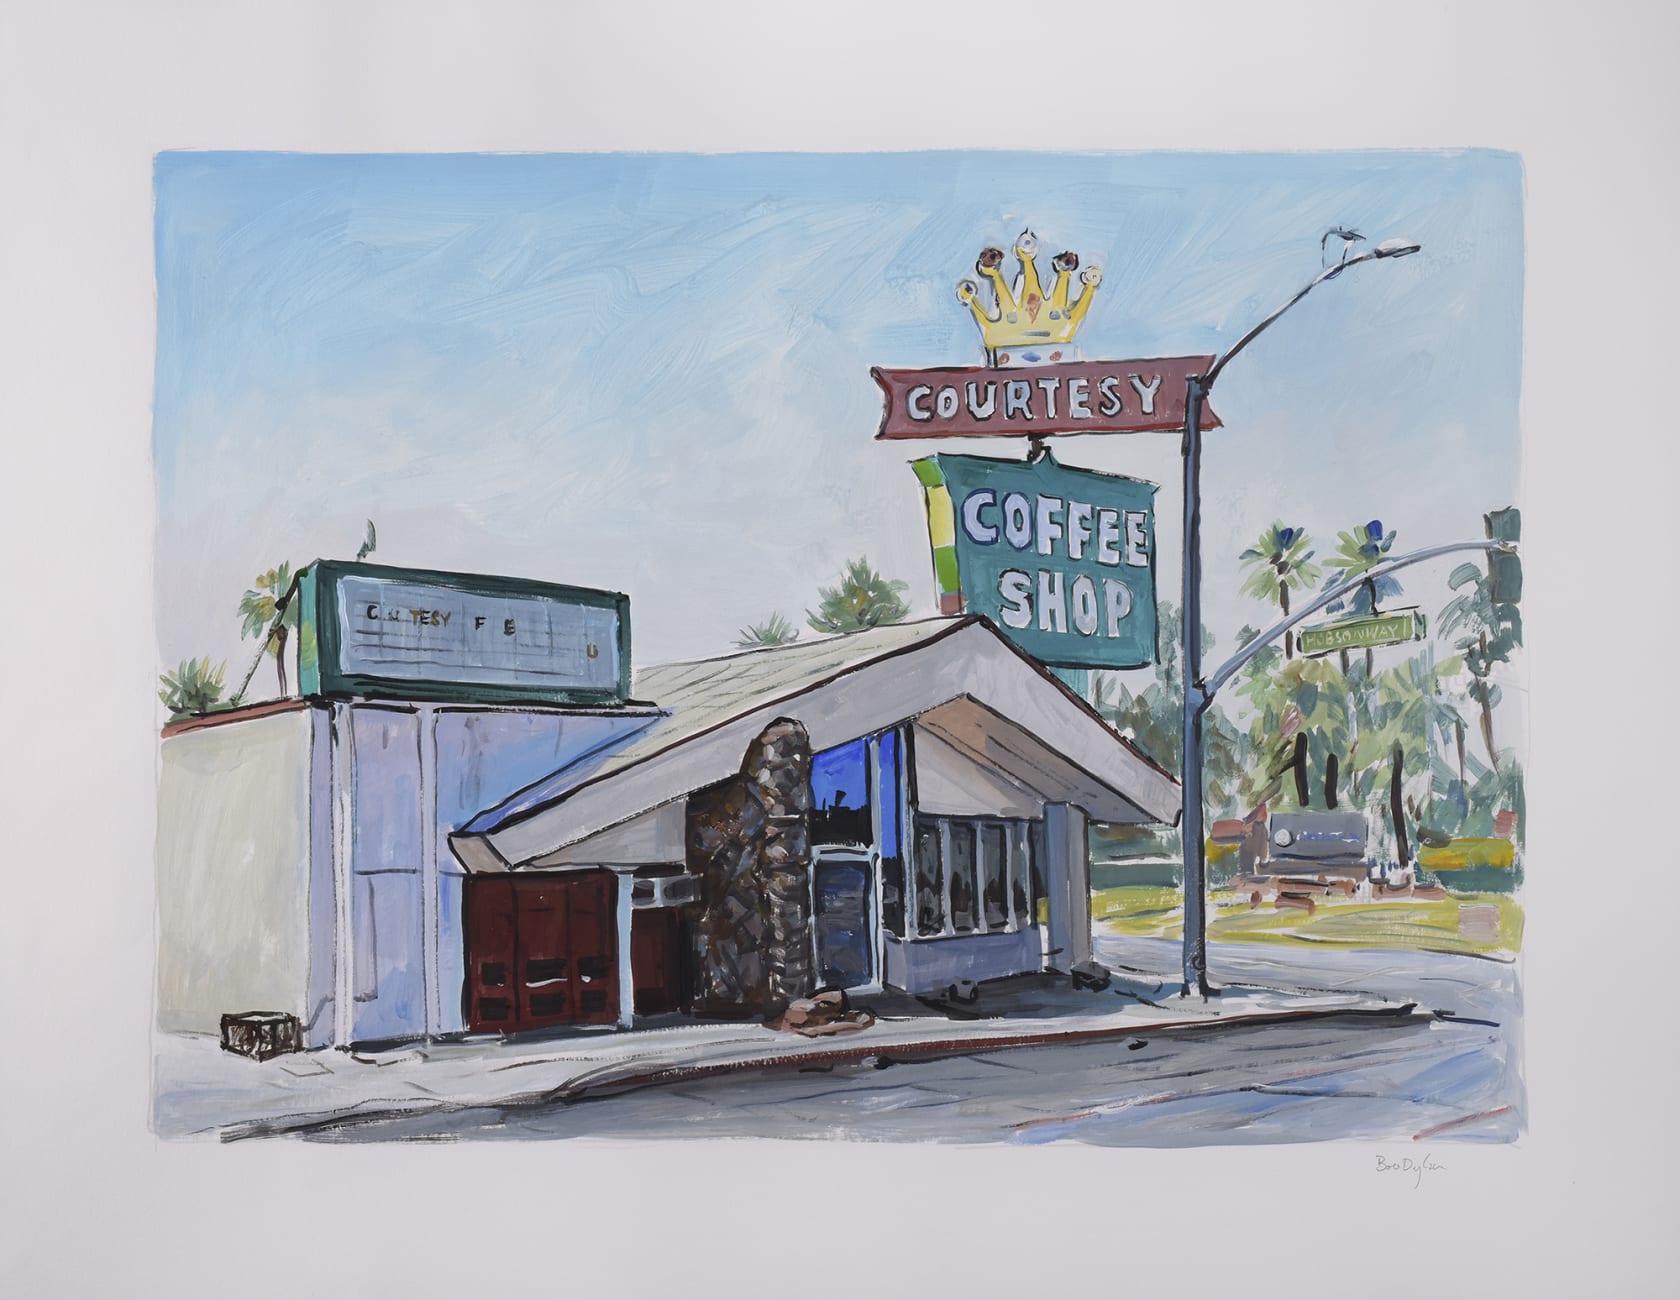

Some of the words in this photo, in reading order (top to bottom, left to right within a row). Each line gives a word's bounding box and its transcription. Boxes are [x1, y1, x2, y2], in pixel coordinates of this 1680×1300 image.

[906, 374, 1161, 421] COURTESY
[961, 488, 1149, 567] COFFEE
[998, 568, 1134, 637] SHOP
